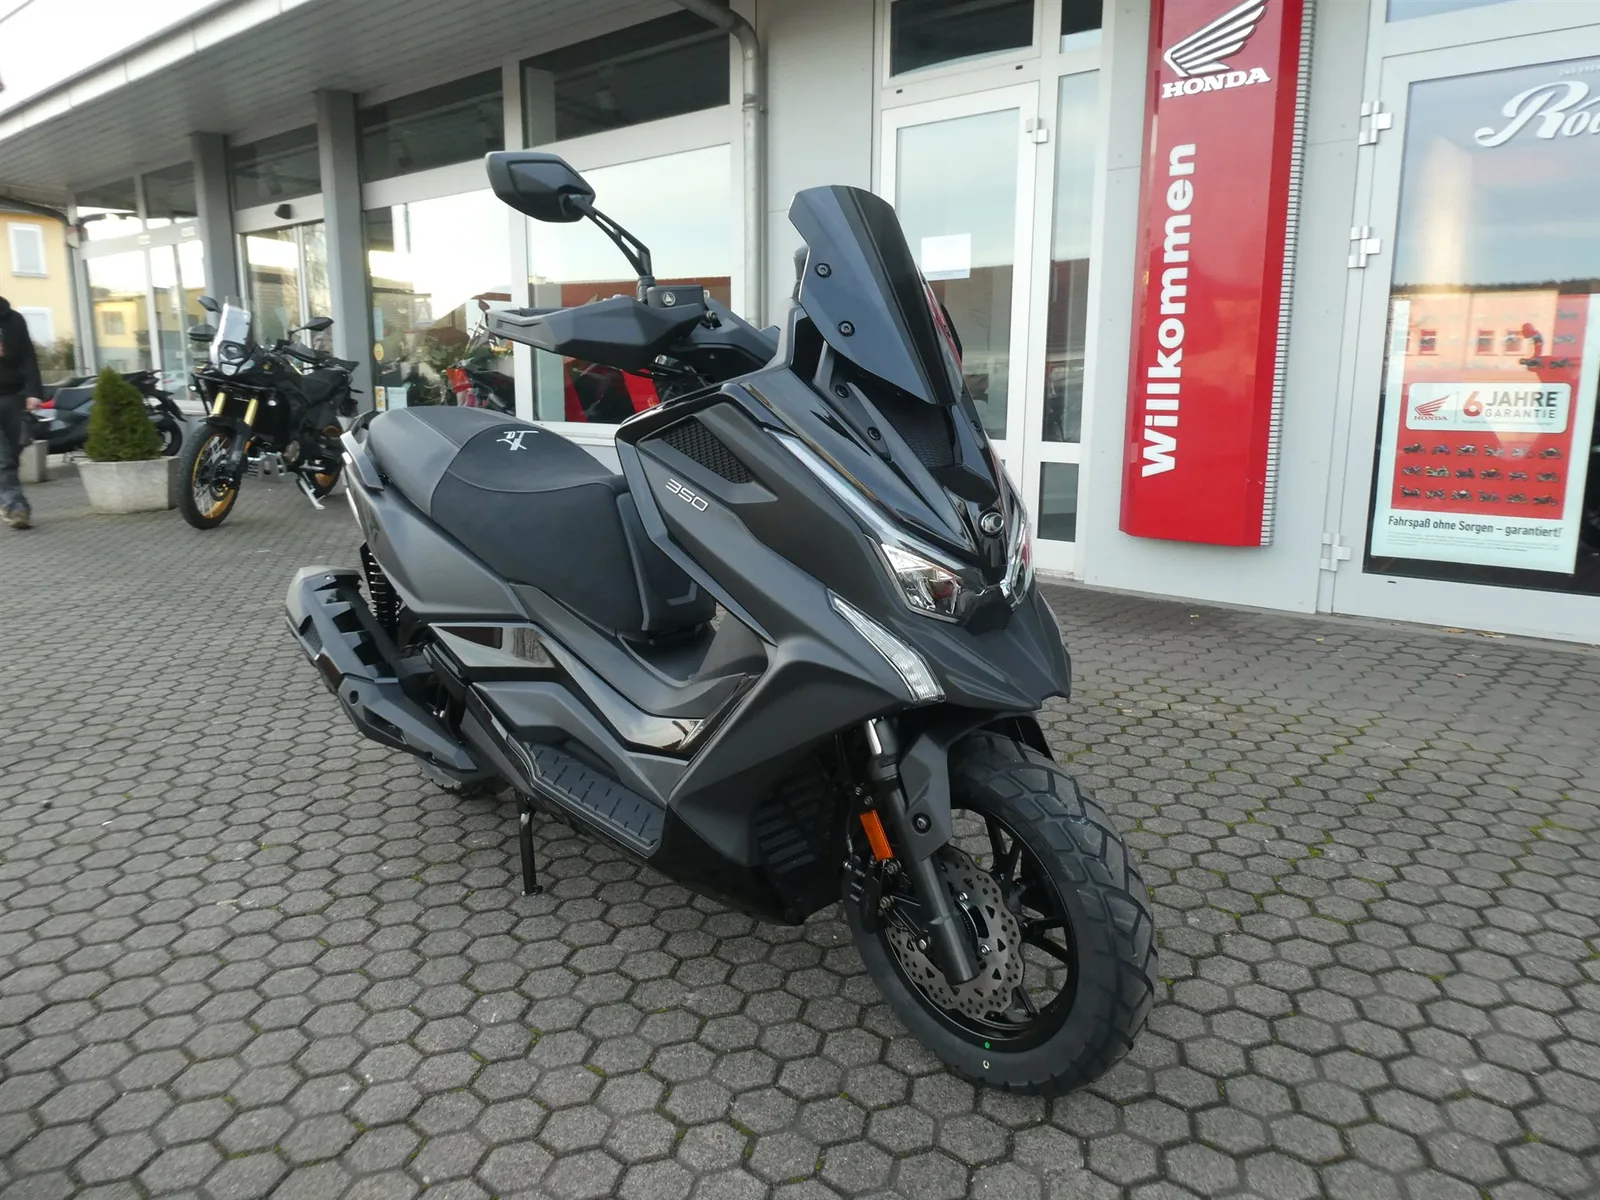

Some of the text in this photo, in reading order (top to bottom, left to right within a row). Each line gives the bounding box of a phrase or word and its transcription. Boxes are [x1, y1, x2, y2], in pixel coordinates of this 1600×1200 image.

[1162, 67, 1271, 98] HONDA
[1141, 142, 1197, 478] Willkommen
[1463, 391, 1559, 417] 6 JAHRE
[1484, 408, 1557, 419] GARANTIE
[665, 478, 709, 512] 350
[1388, 515, 1431, 529] Fahrspaß
[1433, 519, 1456, 530] ohne
[1458, 520, 1494, 534] Sorgen
